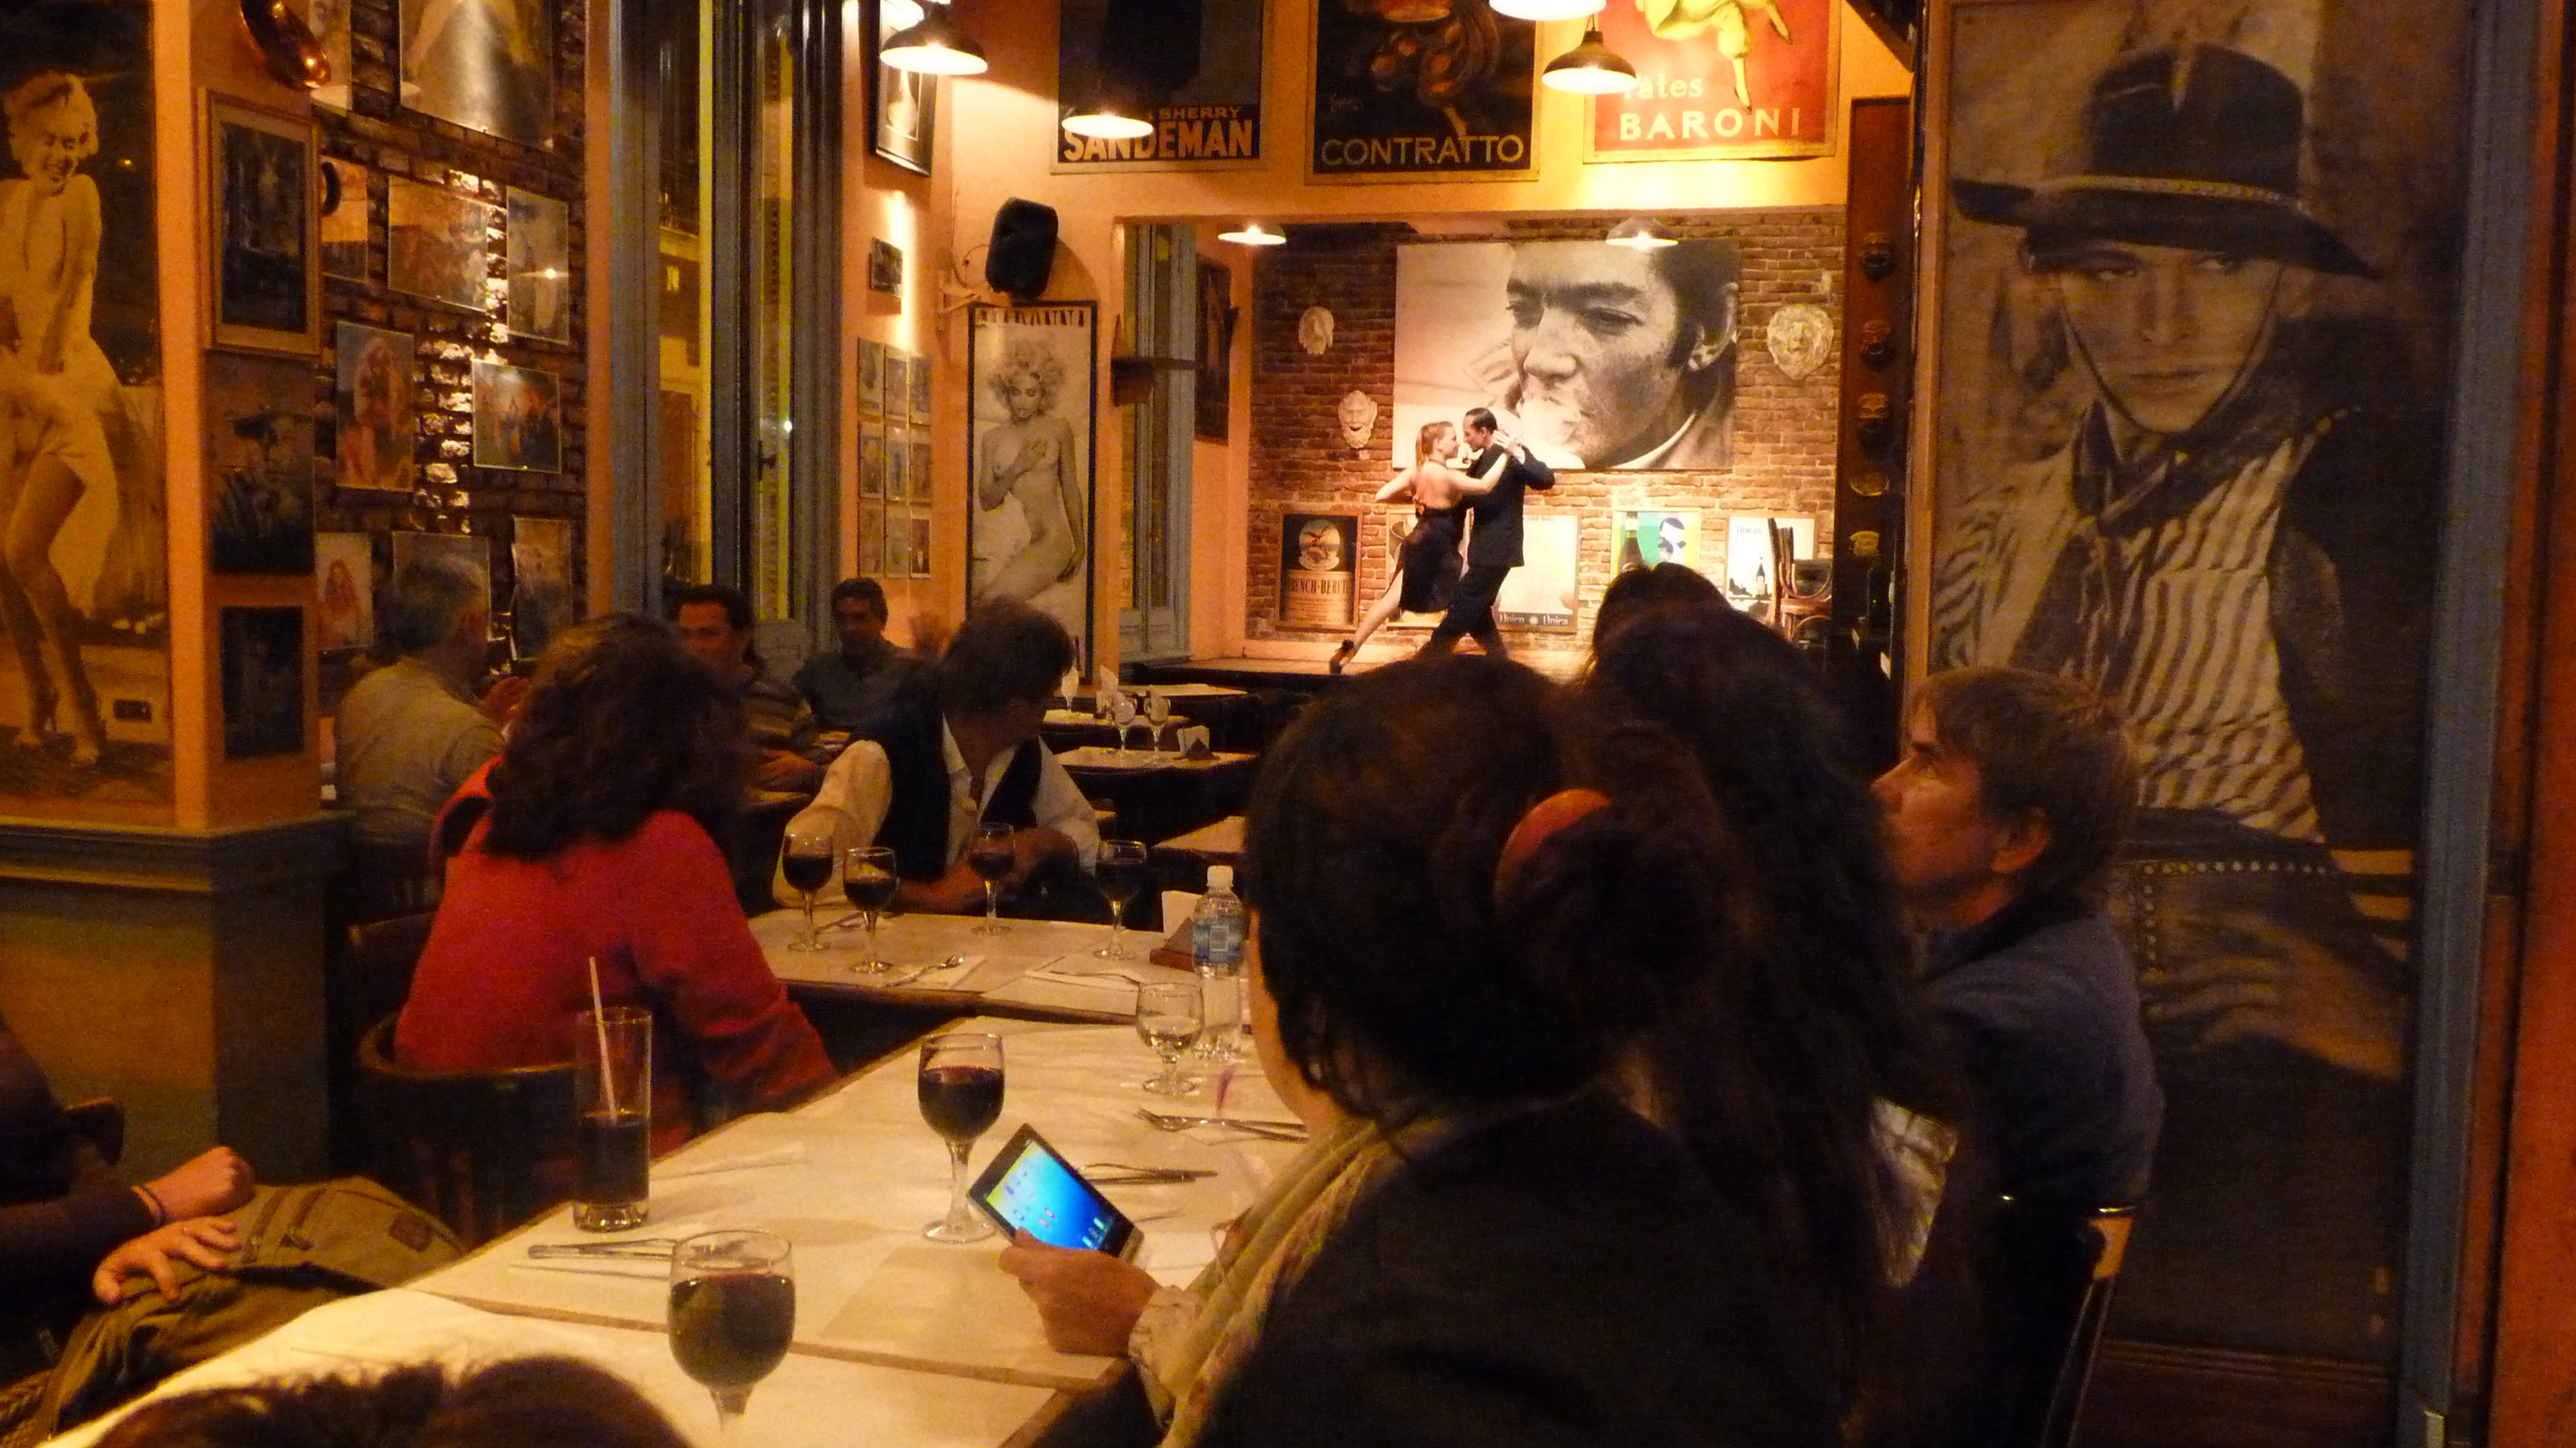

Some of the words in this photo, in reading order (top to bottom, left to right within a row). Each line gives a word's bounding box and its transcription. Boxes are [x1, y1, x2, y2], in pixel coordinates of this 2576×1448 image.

[1160, 106, 1240, 121] SHERRY
[1620, 108, 1801, 140] BARONI
[1064, 119, 1253, 160] SANDEMAN
[1321, 135, 1524, 165] CONTRATTO
